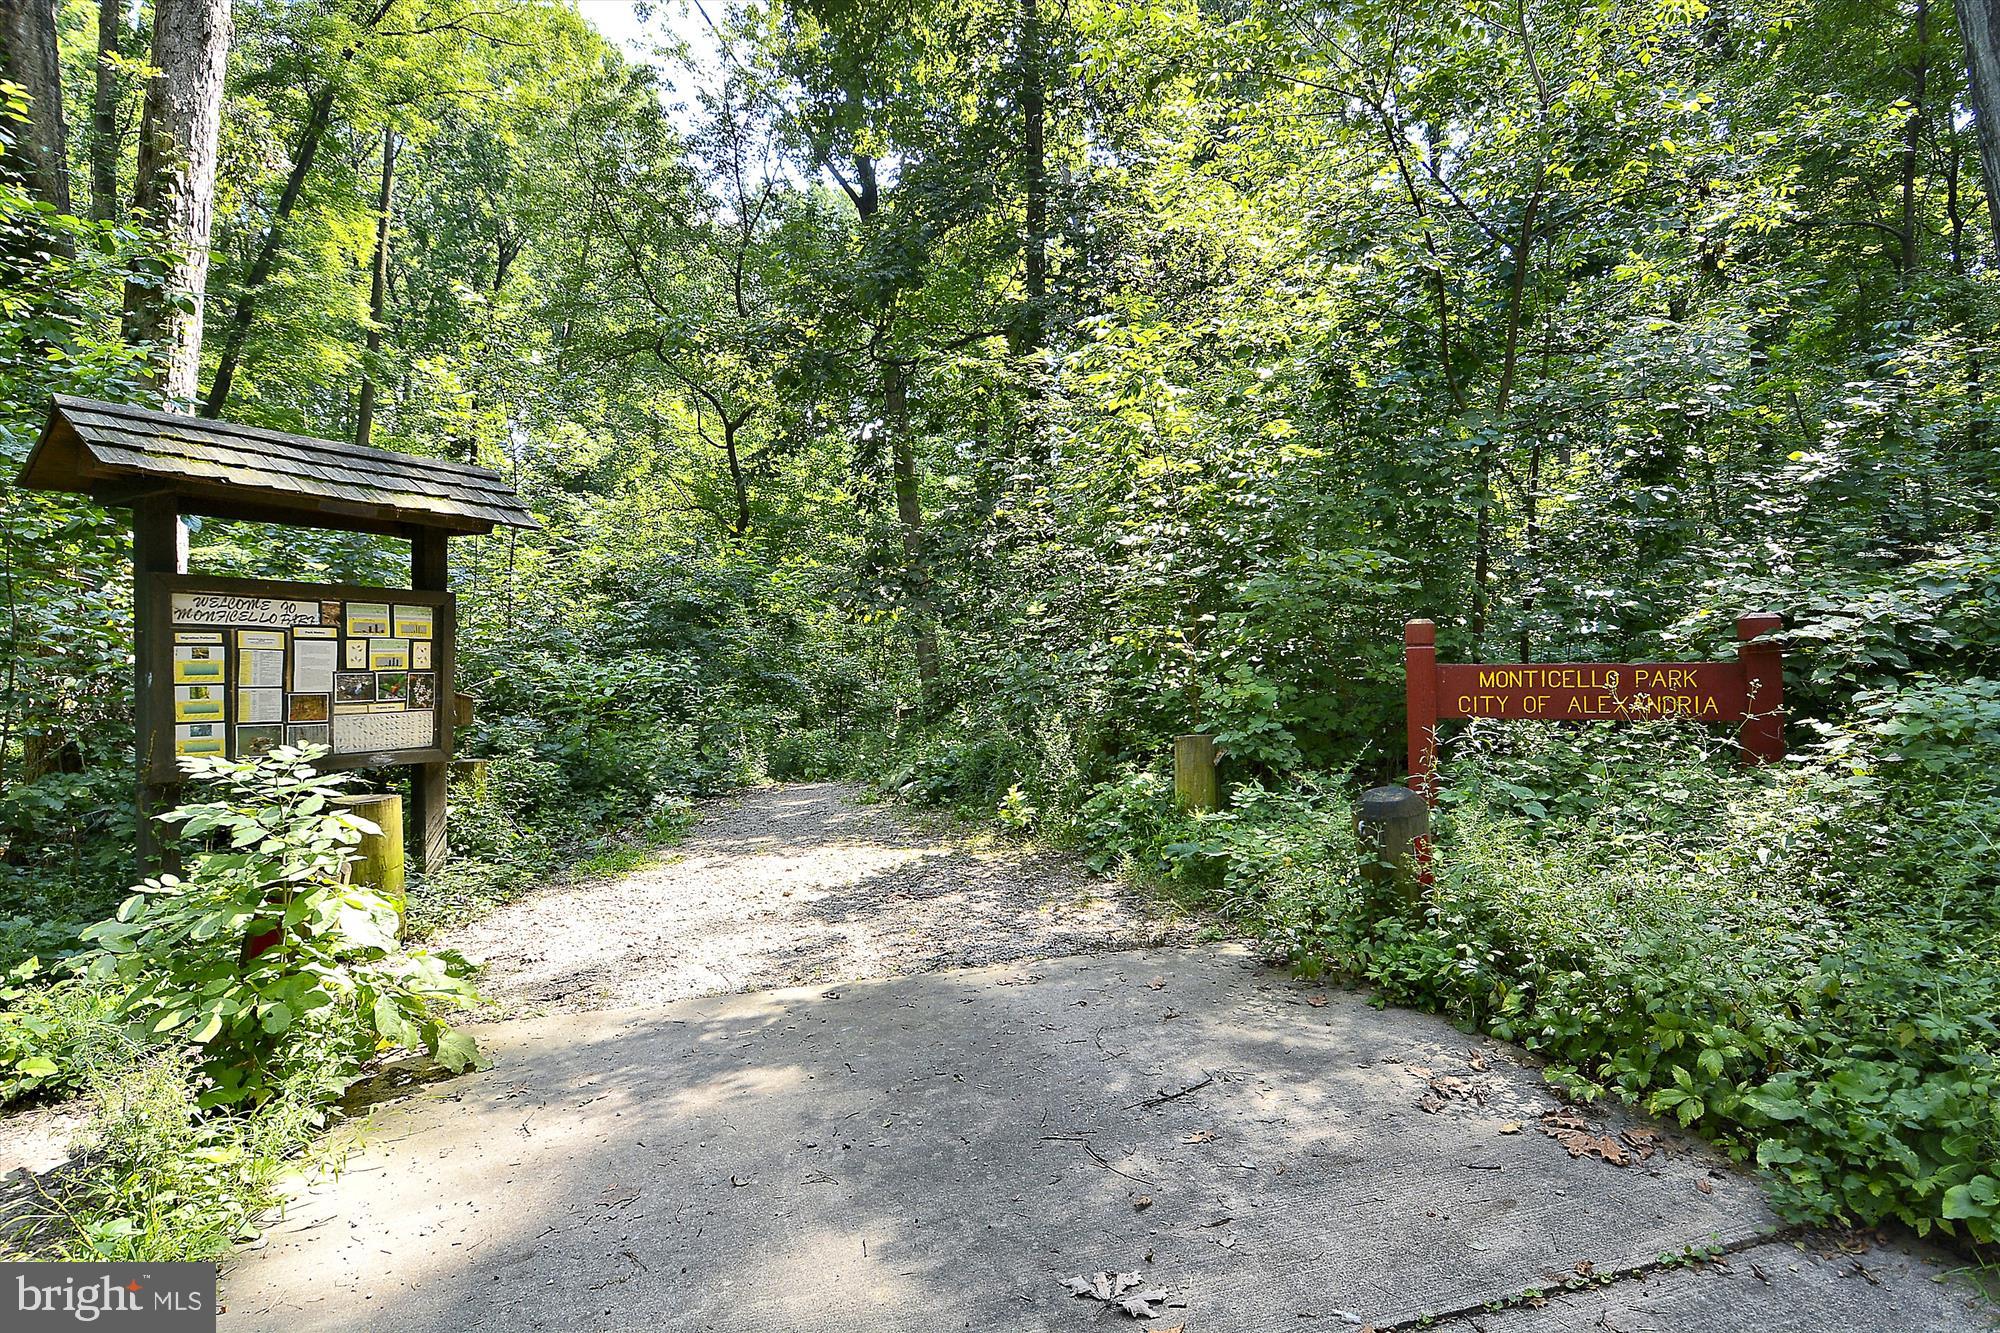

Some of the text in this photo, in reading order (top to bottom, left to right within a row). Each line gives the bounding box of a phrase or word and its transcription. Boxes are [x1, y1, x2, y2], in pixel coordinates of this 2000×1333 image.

[193, 597, 271, 610] WELCOME
[174, 607, 278, 623] MONTICELLO
[1479, 669, 1698, 688] MONTICELLO PARK
[1458, 695, 1719, 714] CITY OF ALEXANDRIA
